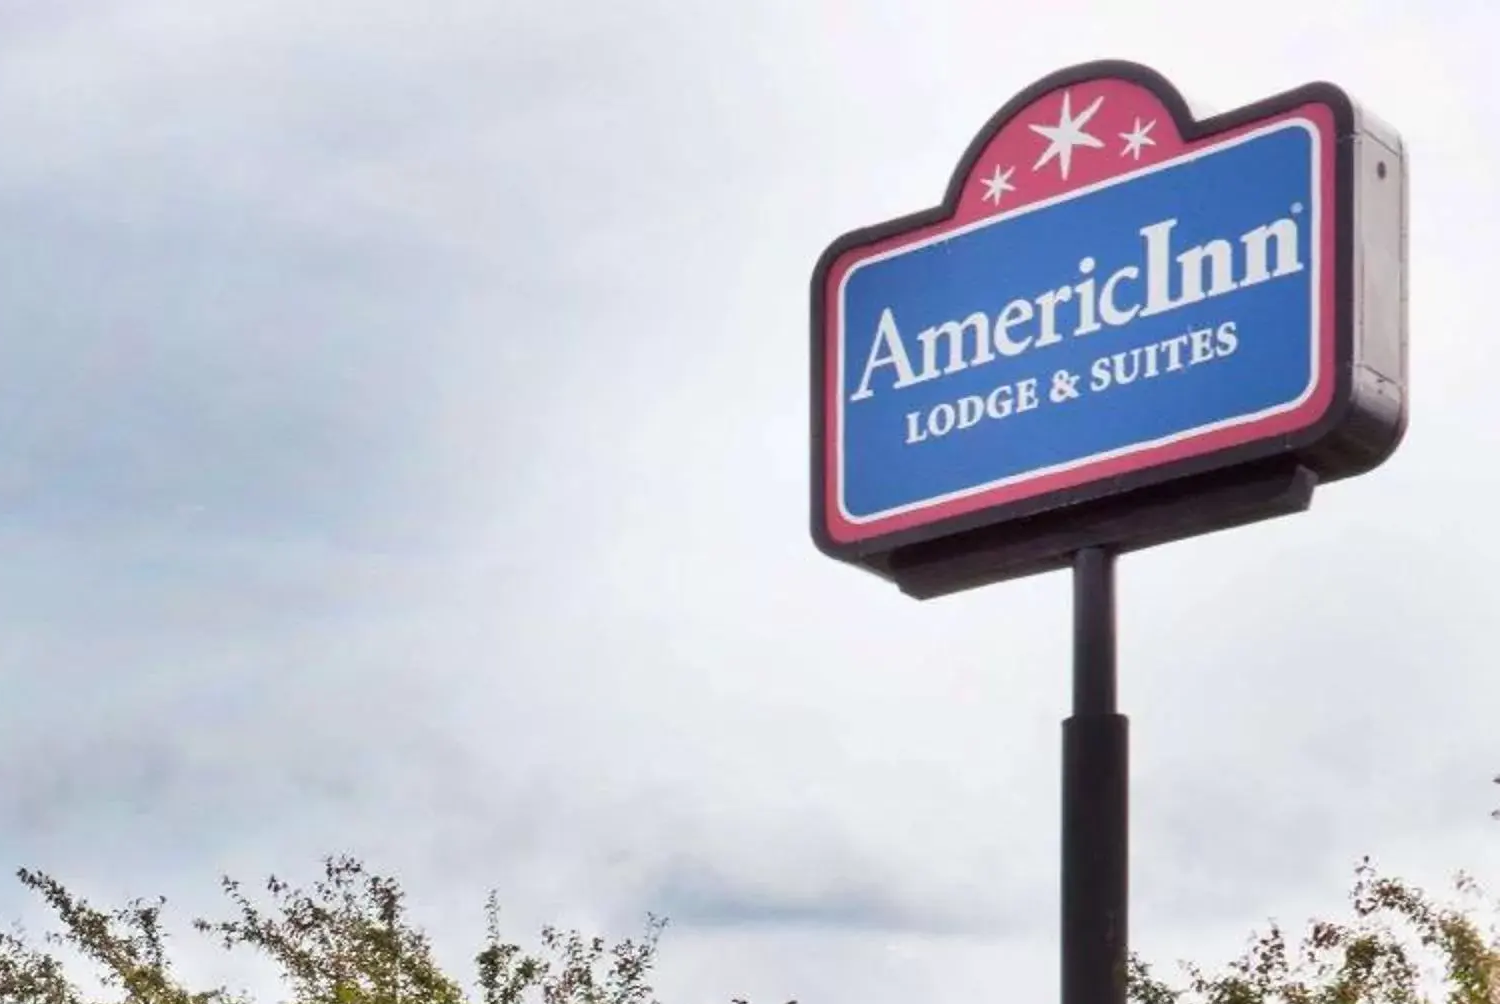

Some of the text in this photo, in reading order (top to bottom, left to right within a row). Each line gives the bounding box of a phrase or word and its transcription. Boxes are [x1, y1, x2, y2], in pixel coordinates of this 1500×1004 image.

[851, 214, 1303, 400] AmericInn
[906, 321, 1239, 444] LODGE & SUITES
